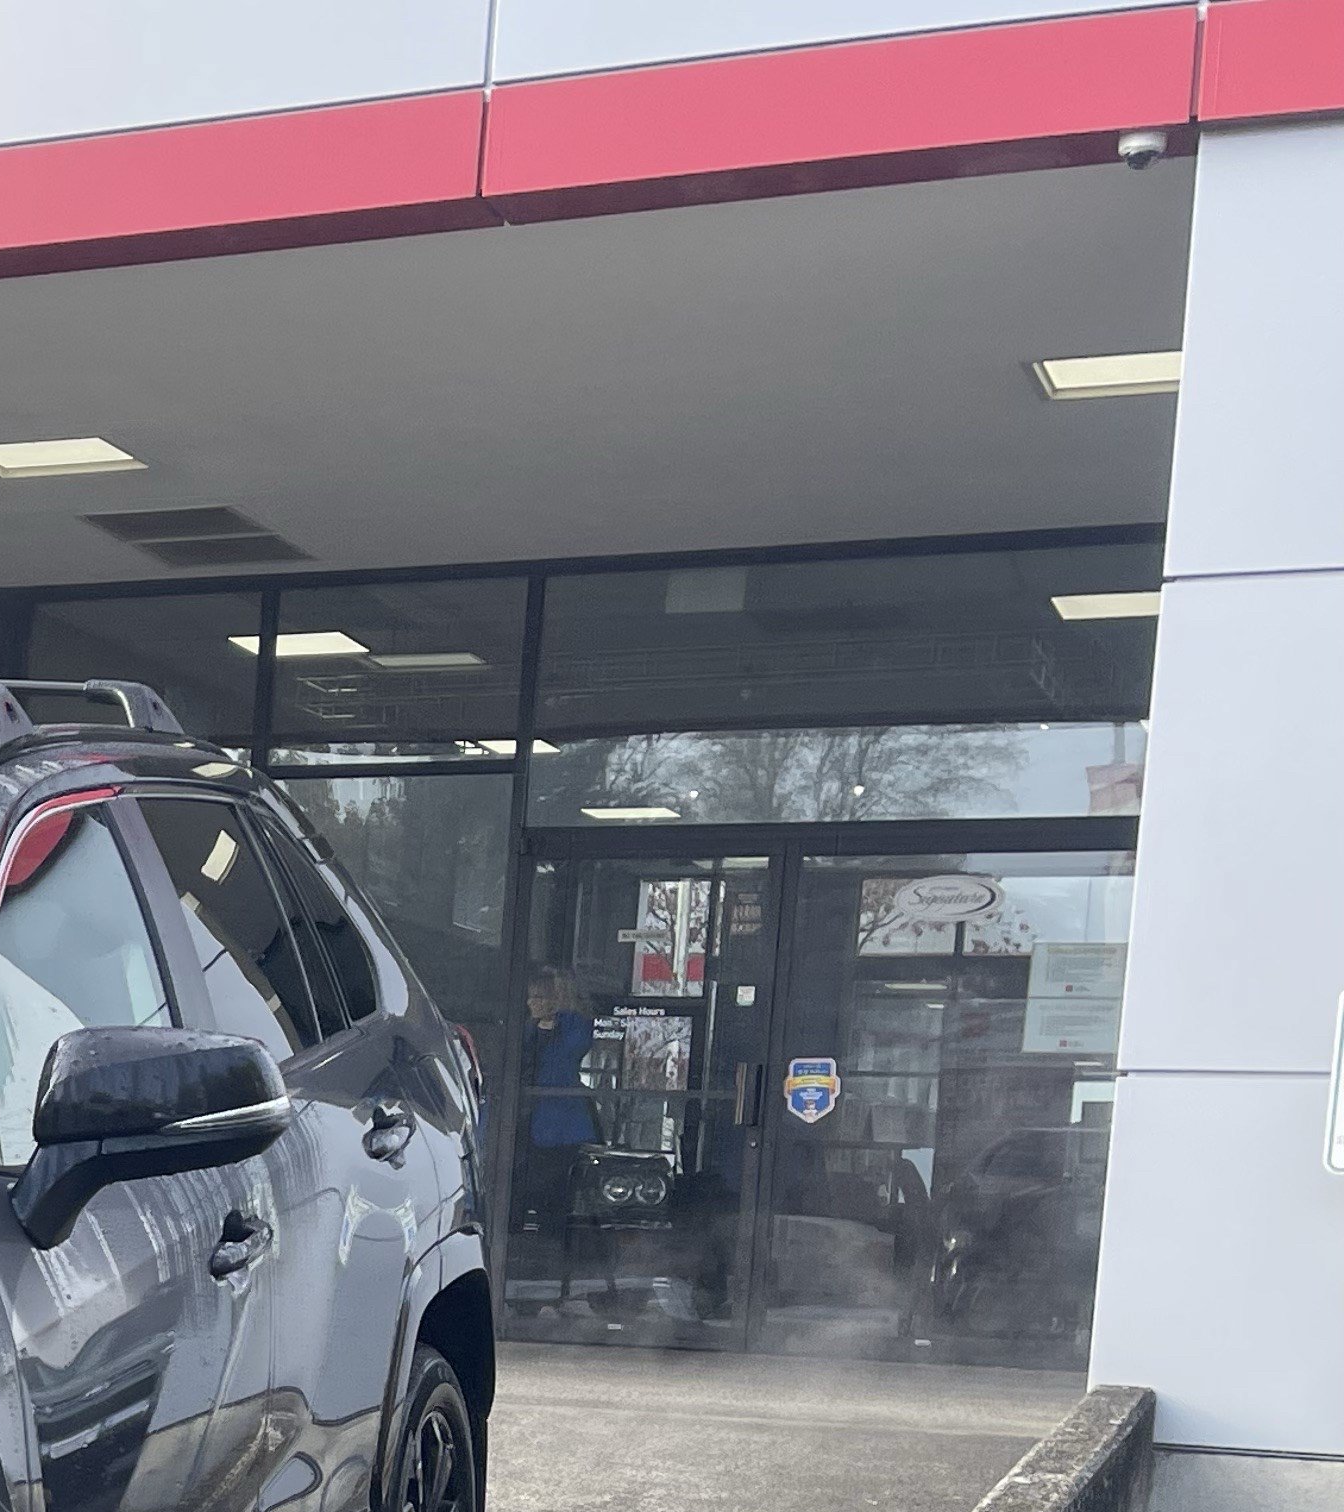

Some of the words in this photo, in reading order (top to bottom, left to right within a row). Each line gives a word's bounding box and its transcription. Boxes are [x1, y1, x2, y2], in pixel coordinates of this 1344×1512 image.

[613, 1005, 637, 1016] Sales
[638, 1006, 665, 1016] Hours
[592, 1029, 625, 1041] Sunday
